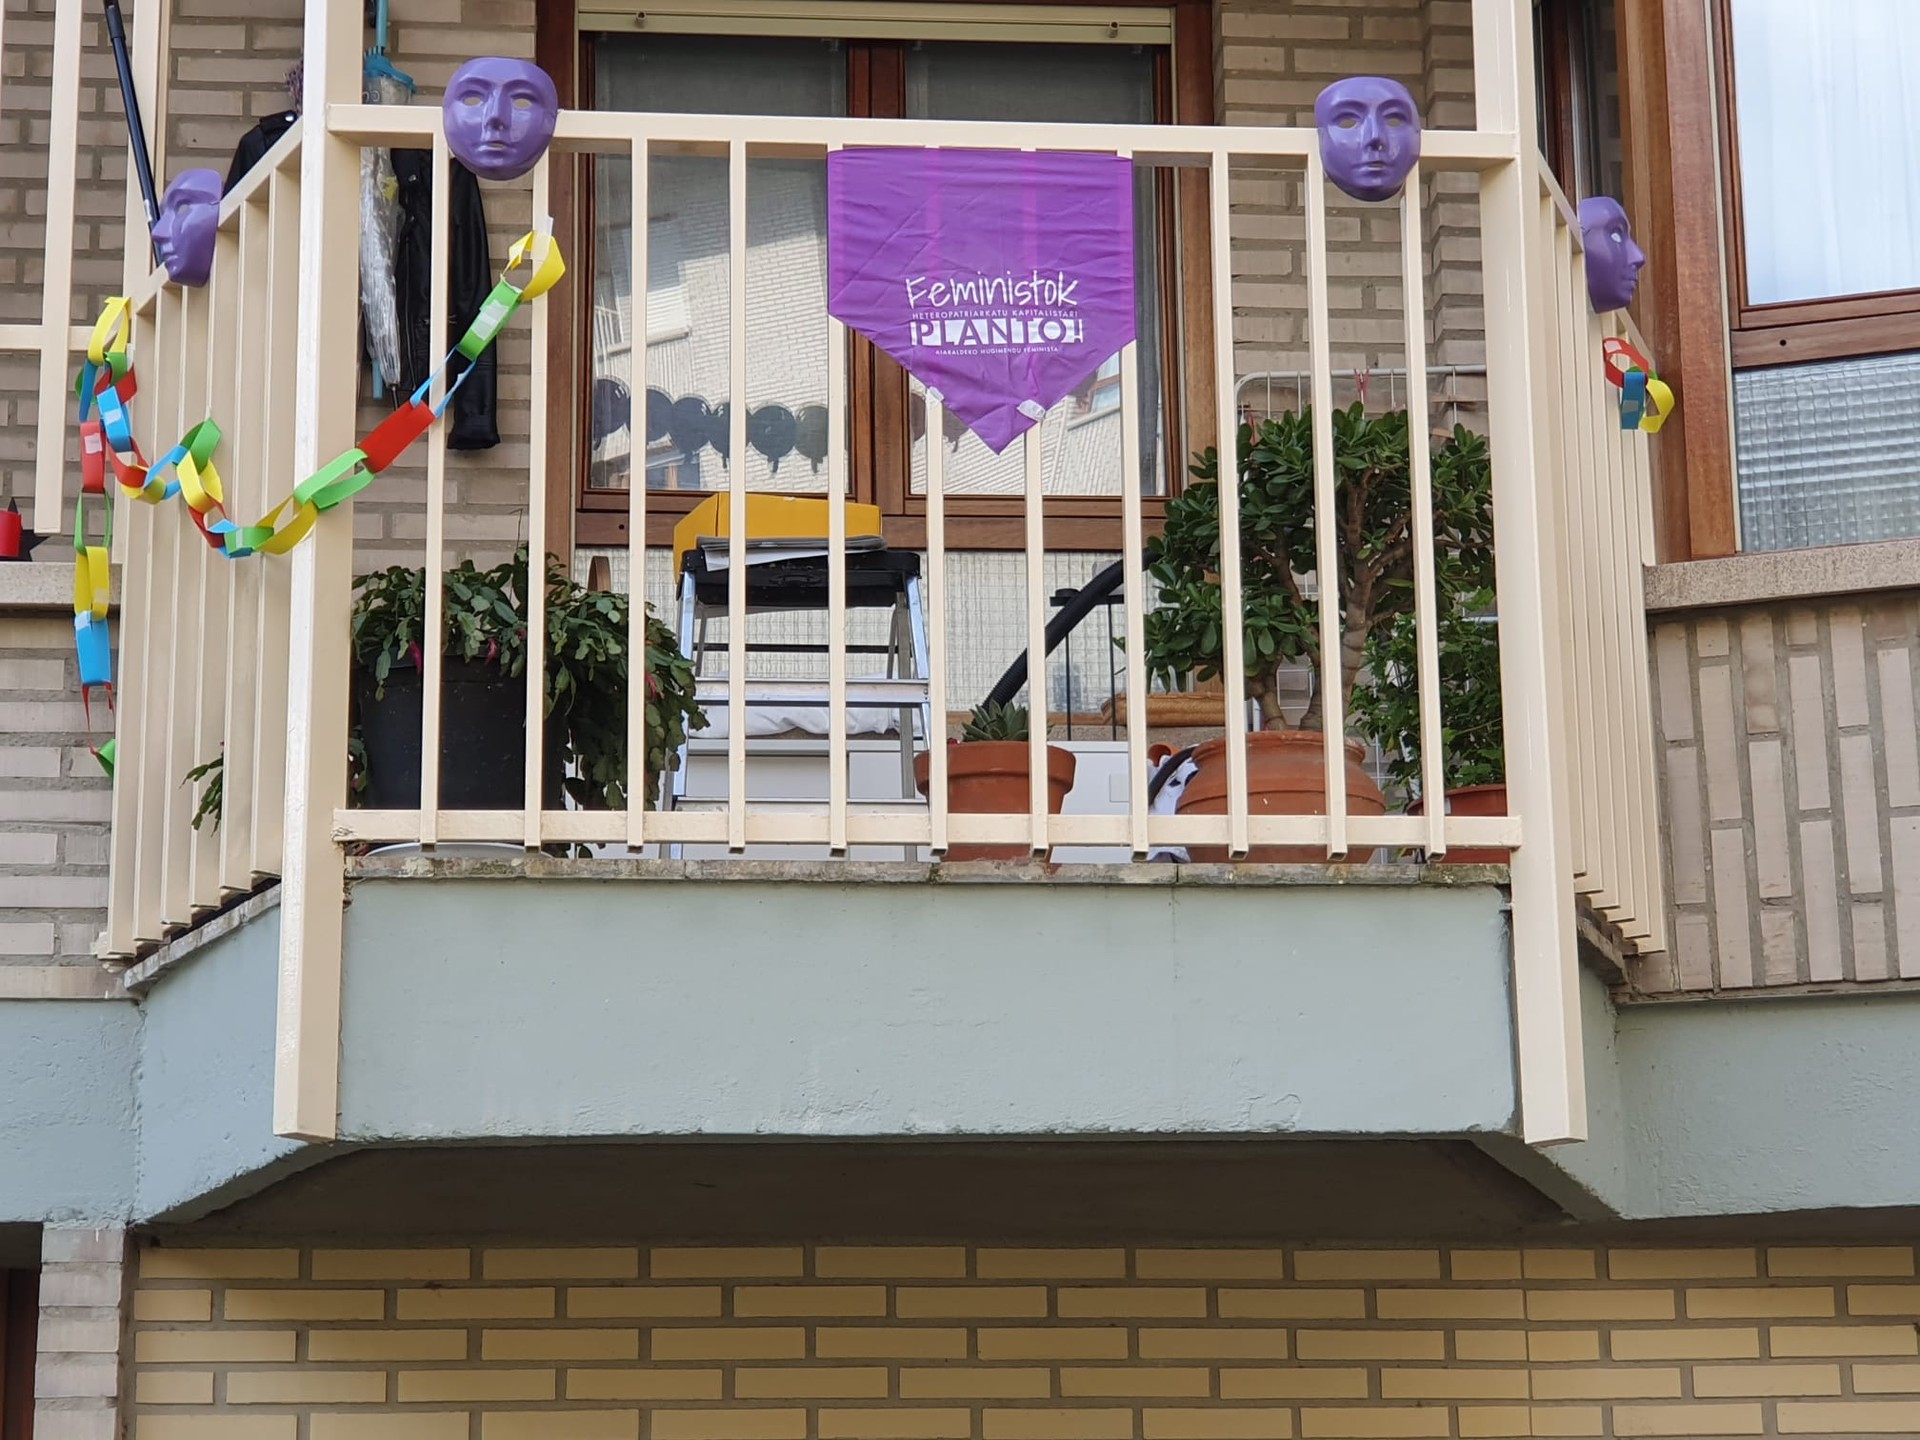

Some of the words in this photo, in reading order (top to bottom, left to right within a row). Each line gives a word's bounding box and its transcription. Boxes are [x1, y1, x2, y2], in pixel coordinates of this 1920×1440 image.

[906, 270, 1079, 309] Feministok
[912, 310, 1008, 320] HETEROPATRIARKATU
[1012, 309, 1078, 318] KAPITALISTARI
